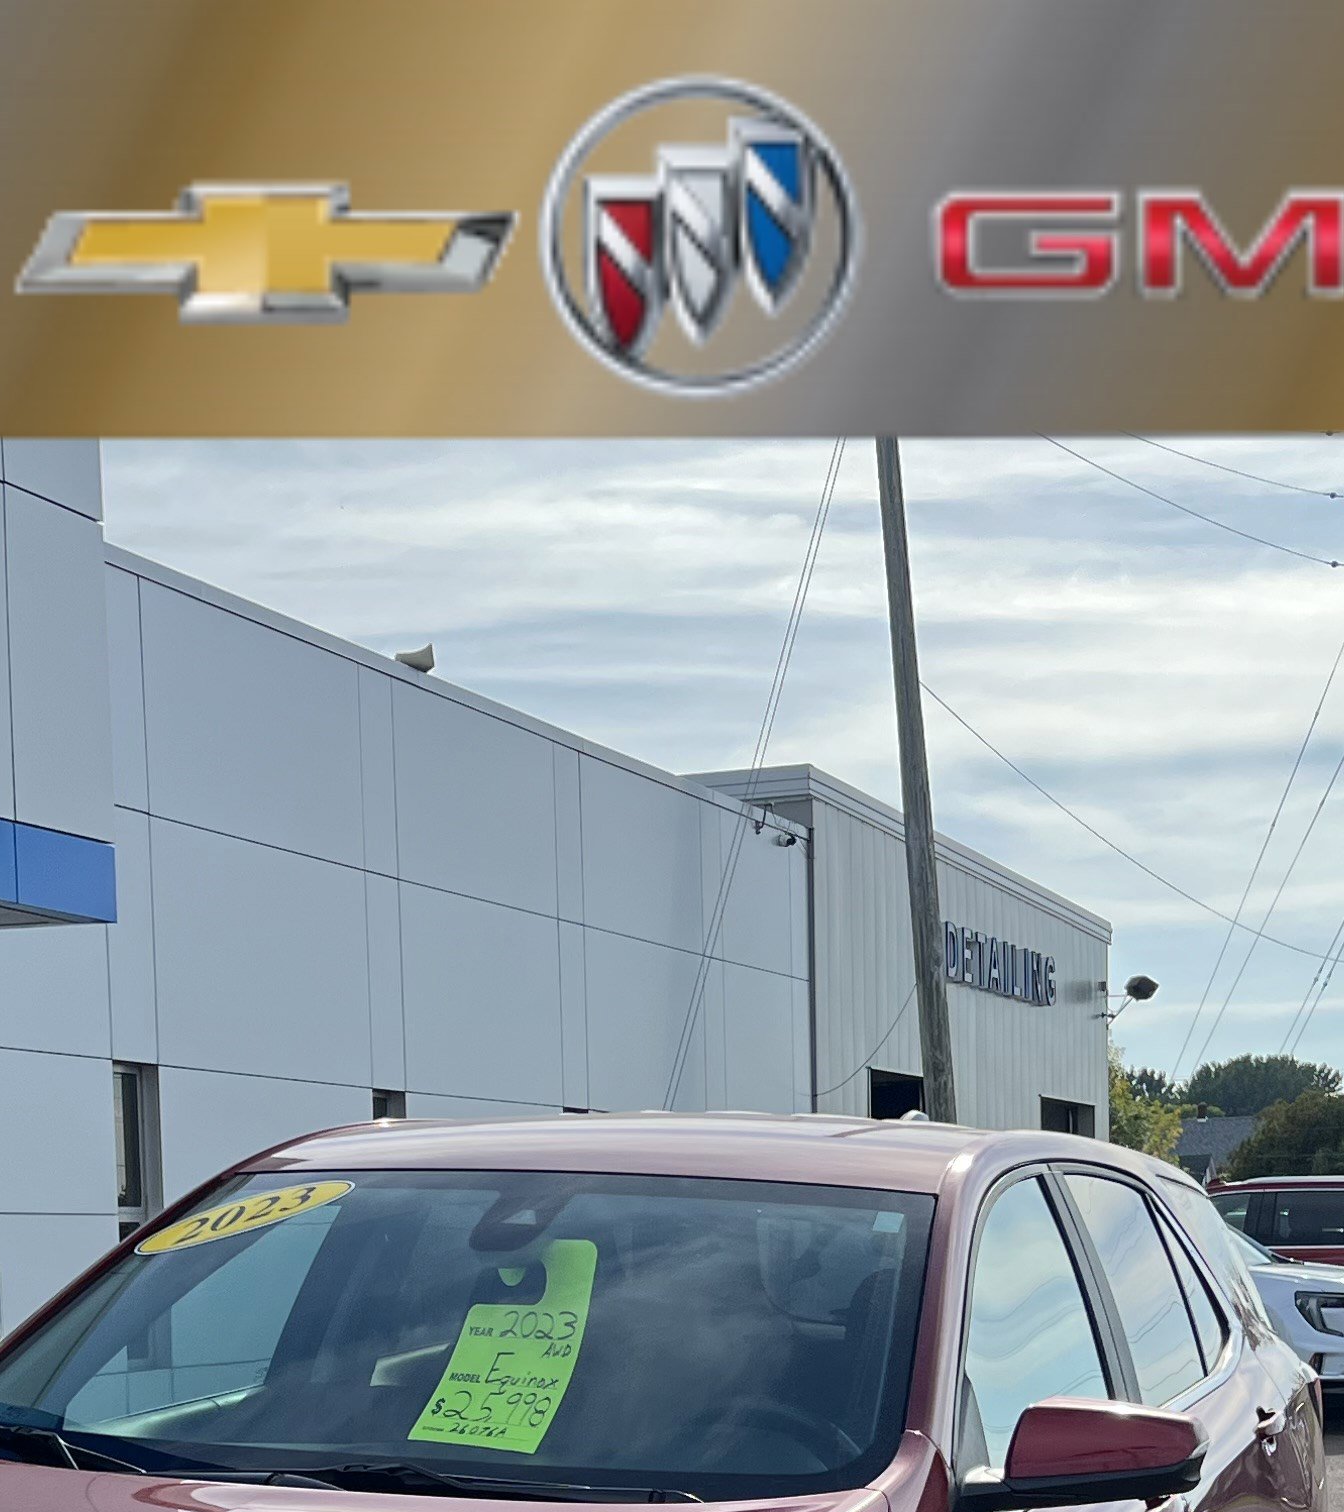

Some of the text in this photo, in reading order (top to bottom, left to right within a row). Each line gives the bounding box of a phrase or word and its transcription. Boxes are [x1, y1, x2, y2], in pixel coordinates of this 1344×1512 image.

[944, 921, 1056, 1007] DETAILING
[172, 1186, 317, 1246] 2023
[468, 1310, 578, 1340] YEAR 2023
[448, 1352, 559, 1394] MODEL Equinox
